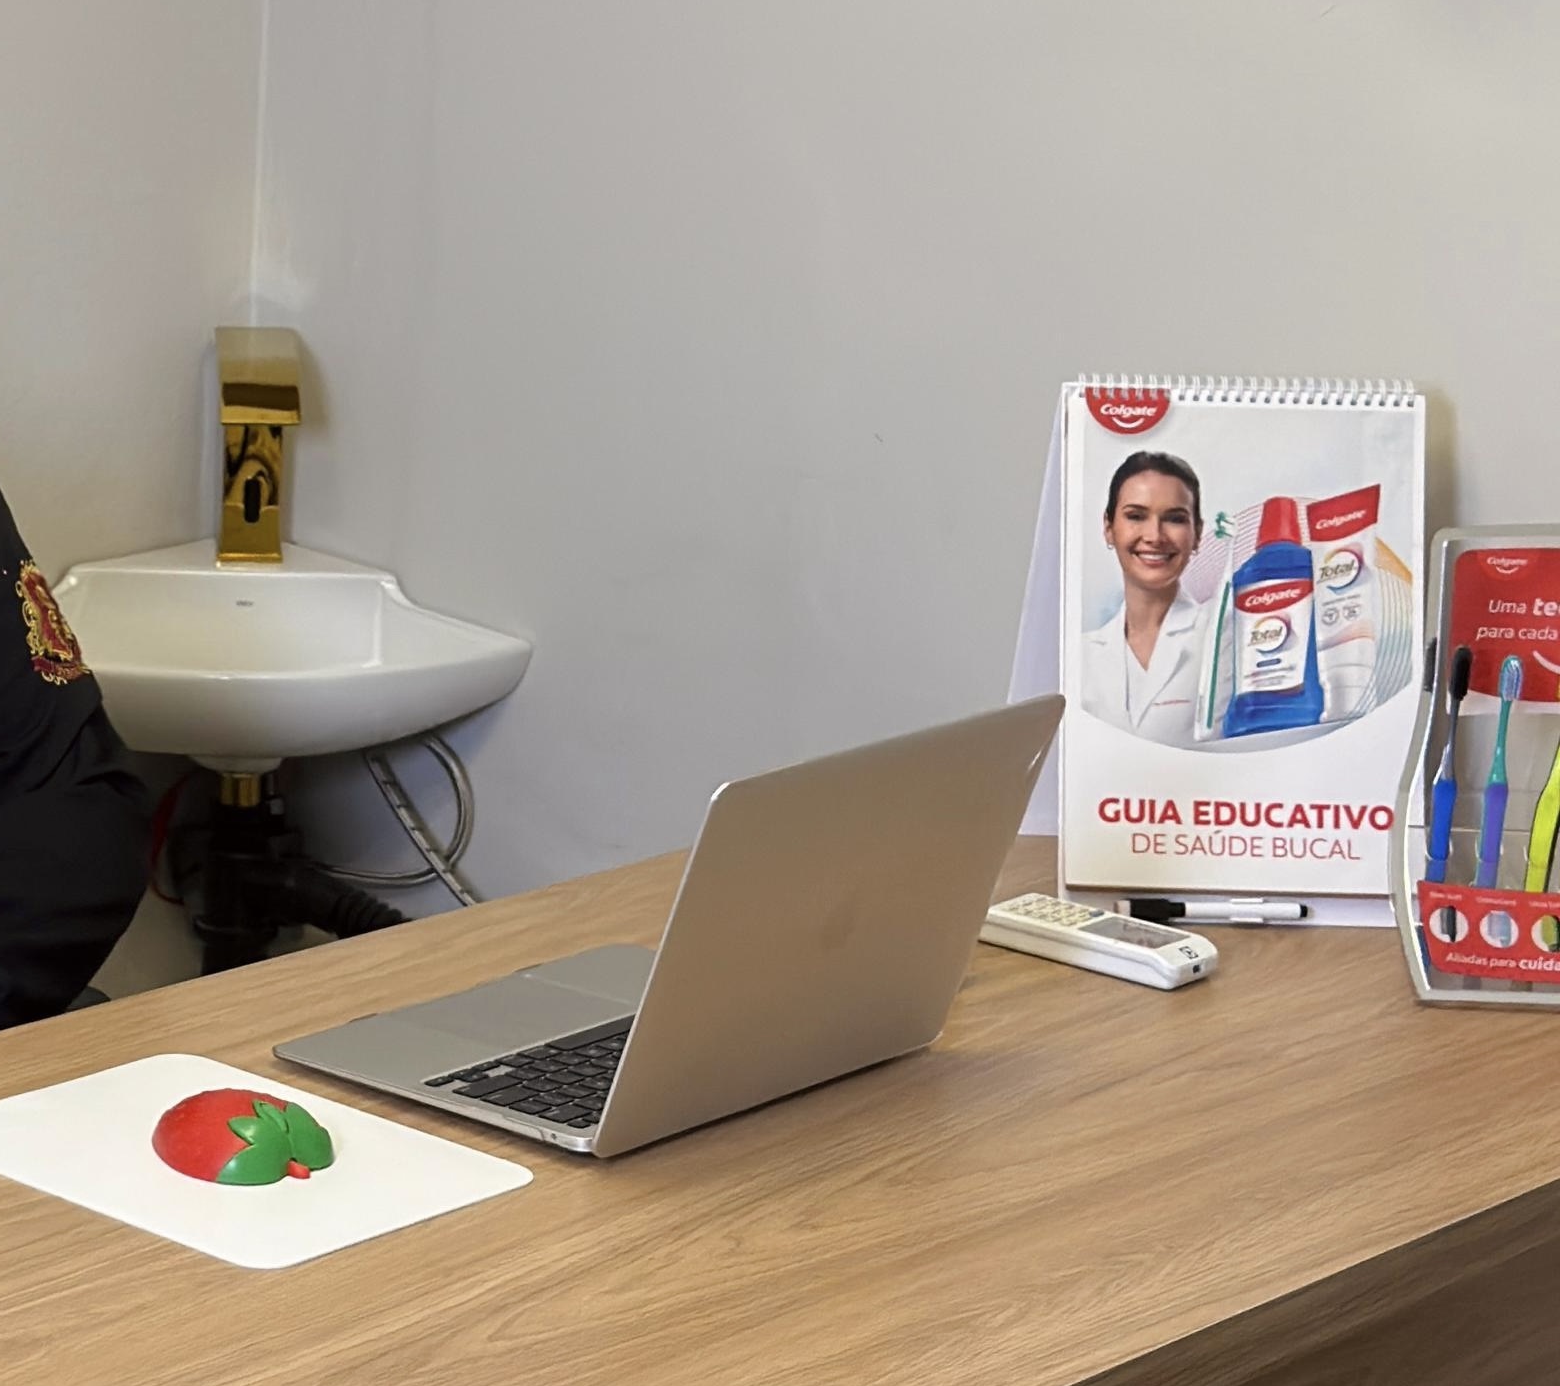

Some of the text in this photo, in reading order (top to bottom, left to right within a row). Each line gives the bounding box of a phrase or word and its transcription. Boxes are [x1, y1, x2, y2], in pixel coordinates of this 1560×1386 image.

[1100, 403, 1157, 418] Colgate
[1315, 509, 1367, 530] Colgate
[1319, 559, 1355, 580] Total
[1245, 588, 1301, 607] Colgate
[1488, 598, 1560, 616] Uma te
[1250, 625, 1283, 644] Total
[1475, 625, 1558, 641] para cada
[1097, 797, 1395, 831] GUIA EDUCATIVO
[1131, 829, 1361, 860] DE SAÚDE BUCAL
[1489, 958, 1517, 968] para
